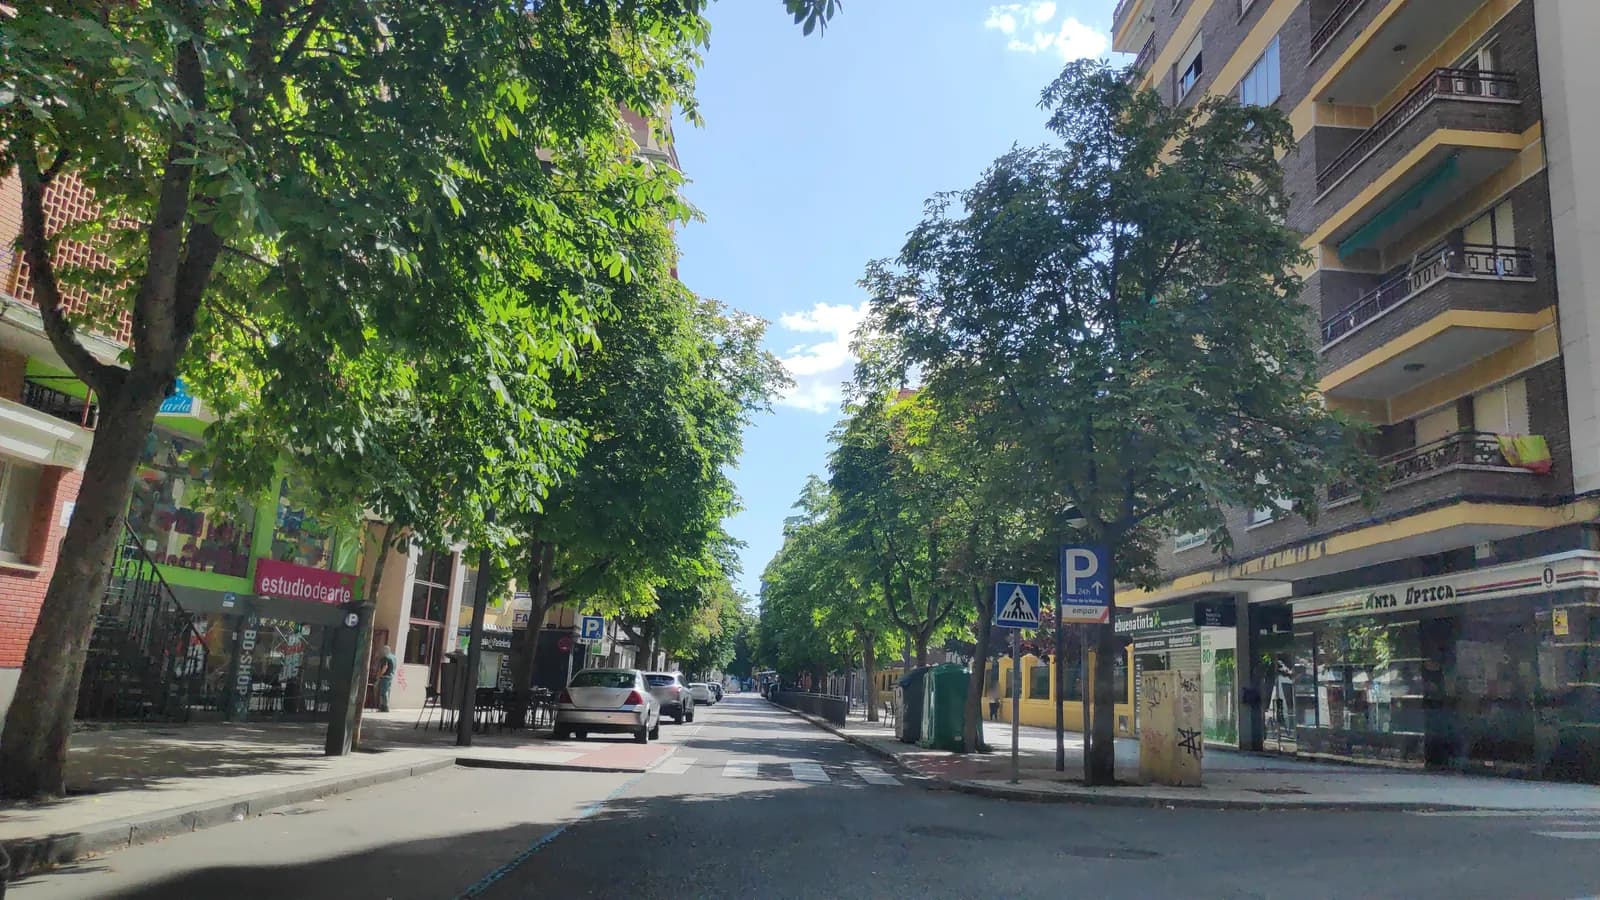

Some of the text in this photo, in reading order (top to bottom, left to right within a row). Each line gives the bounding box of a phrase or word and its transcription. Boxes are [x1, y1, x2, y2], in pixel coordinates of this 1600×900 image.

[1066, 548, 1098, 595] P
[261, 576, 350, 603] estudiodearte
[515, 613, 529, 622] FA
[1114, 614, 1154, 632] ebuenatinta
[585, 619, 599, 637] P
